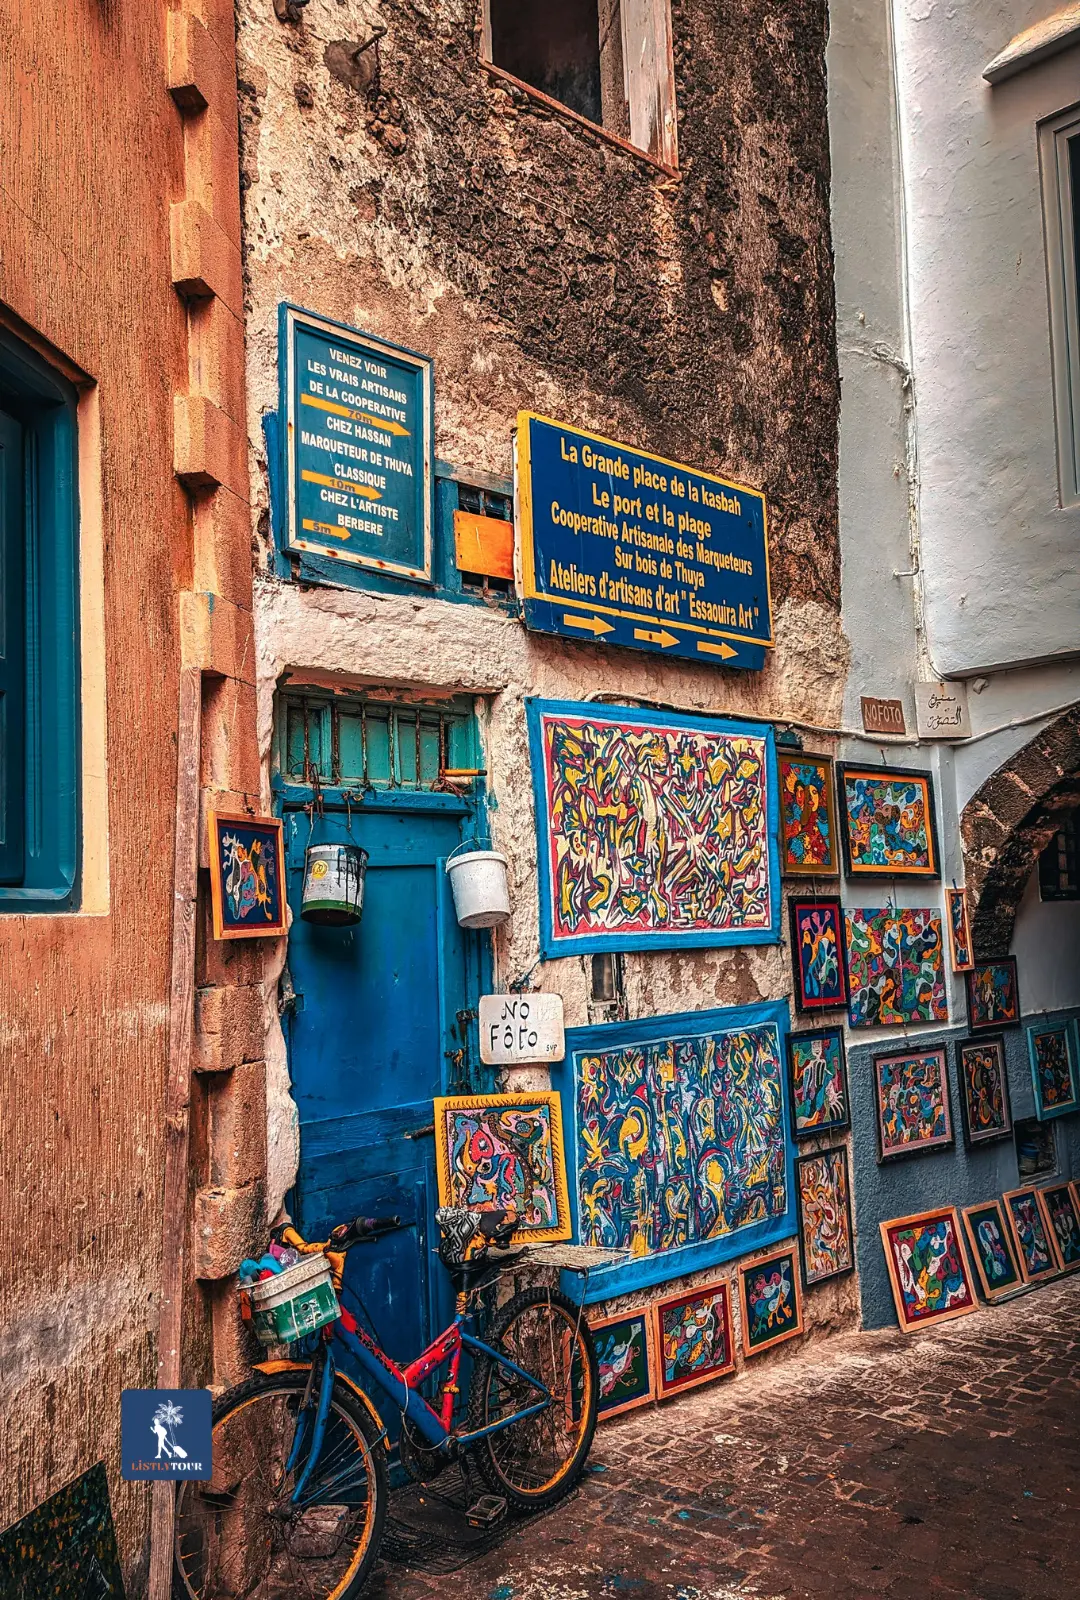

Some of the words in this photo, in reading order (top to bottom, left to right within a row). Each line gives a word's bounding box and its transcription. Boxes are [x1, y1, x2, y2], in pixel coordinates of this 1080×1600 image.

[329, 348, 362, 369] VENEZ
[364, 361, 387, 379] VOIR
[307, 360, 327, 376] LES
[329, 367, 359, 387] VRAIS
[361, 379, 407, 404] ARTISANS
[309, 380, 323, 395] DE
[326, 385, 339, 400] LA
[341, 391, 406, 423] COOPERATIVE
[348, 409, 373, 425] 70m
[326, 416, 352, 436] CHEZ
[355, 425, 391, 448] HASSAN
[301, 431, 368, 462] MARQUETEUR
[370, 451, 382, 466] DE
[384, 456, 413, 477] THUYA
[329, 479, 355, 493] 10m
[334, 463, 386, 489] CLASSIQUE
[560, 437, 578, 464] La
[582, 445, 629, 480] Grande
[633, 464, 667, 492] place
[670, 475, 685, 498] de
[688, 480, 699, 503] la
[701, 485, 741, 516] kasbah
[320, 489, 348, 507] CHEZ
[350, 497, 399, 521] L'ARTISTE
[592, 482, 610, 508] Le
[613, 494, 642, 518] port
[645, 502, 659, 523] et
[662, 504, 674, 528] la
[678, 511, 711, 540] plage
[313, 523, 331, 535] 5m
[337, 514, 383, 536] BERBERE
[551, 501, 618, 540] Cooperative
[621, 521, 674, 555] Artisanale
[676, 537, 694, 560] des
[696, 542, 753, 576] Marqueteurs
[615, 545, 633, 570] Sur
[635, 550, 658, 576] bois
[660, 558, 673, 579] de
[674, 561, 705, 591] Thuya
[550, 559, 597, 597] Ateliers
[599, 571, 653, 609] d'artisans
[655, 584, 680, 615] d'art
[501, 1001, 530, 1020] NO
